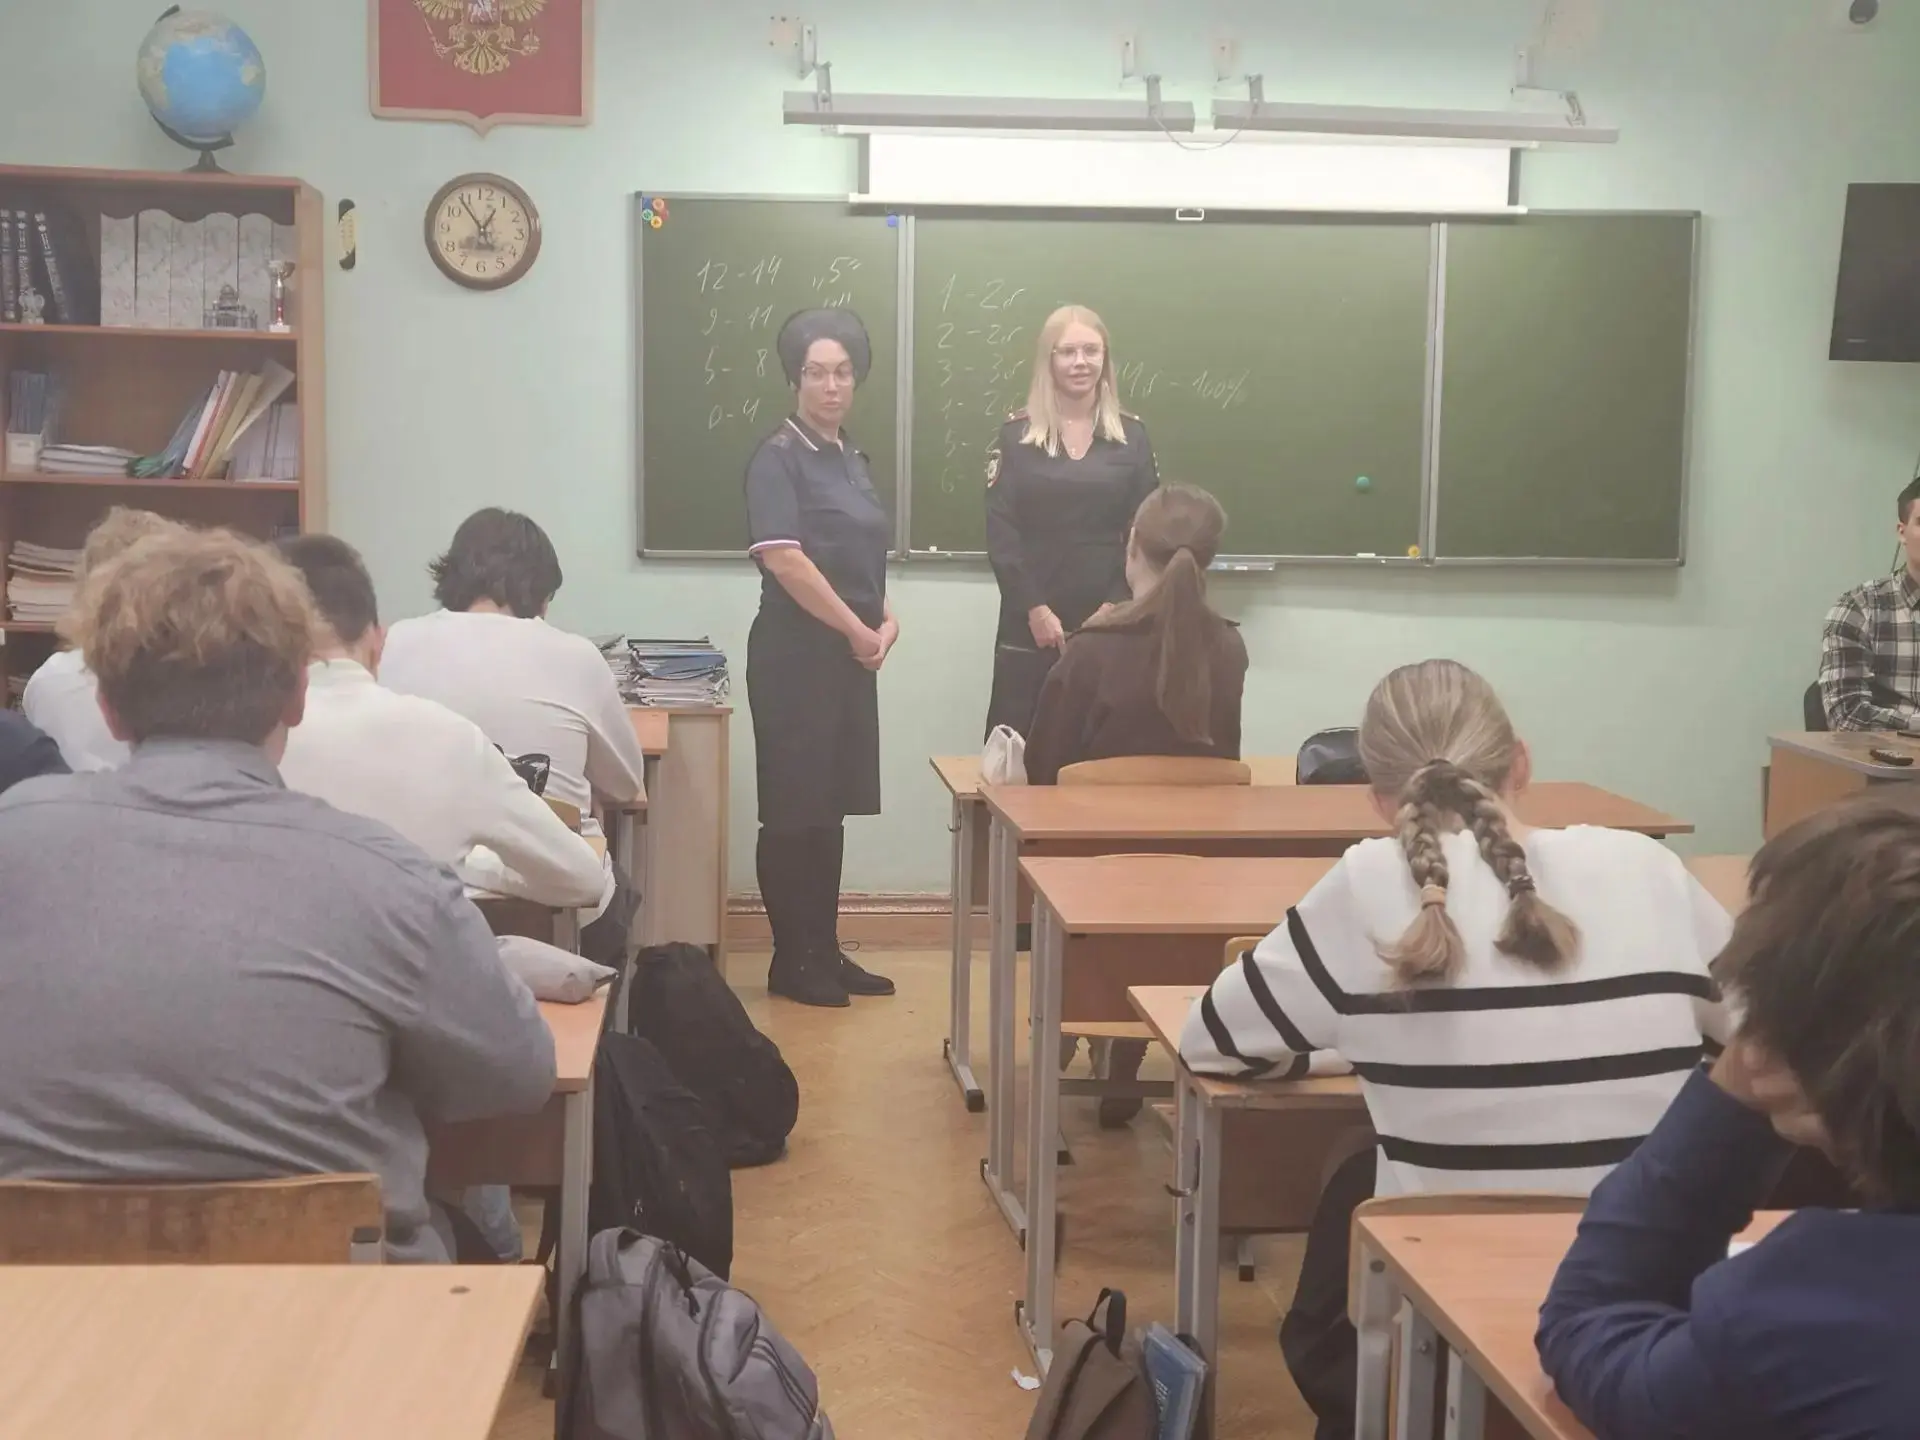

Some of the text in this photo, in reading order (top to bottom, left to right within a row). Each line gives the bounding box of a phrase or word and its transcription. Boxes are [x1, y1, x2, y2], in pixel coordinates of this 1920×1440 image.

[478, 187, 495, 201] 12
[501, 195, 506, 209] 1
[447, 205, 462, 218] 10
[510, 210, 521, 223] 2
[440, 221, 451, 233] 9
[513, 228, 525, 241] 3
[445, 240, 456, 253] 8
[508, 244, 517, 259] 4
[459, 253, 469, 267] 7
[476, 260, 487, 273] 6
[495, 256, 506, 270] 5
